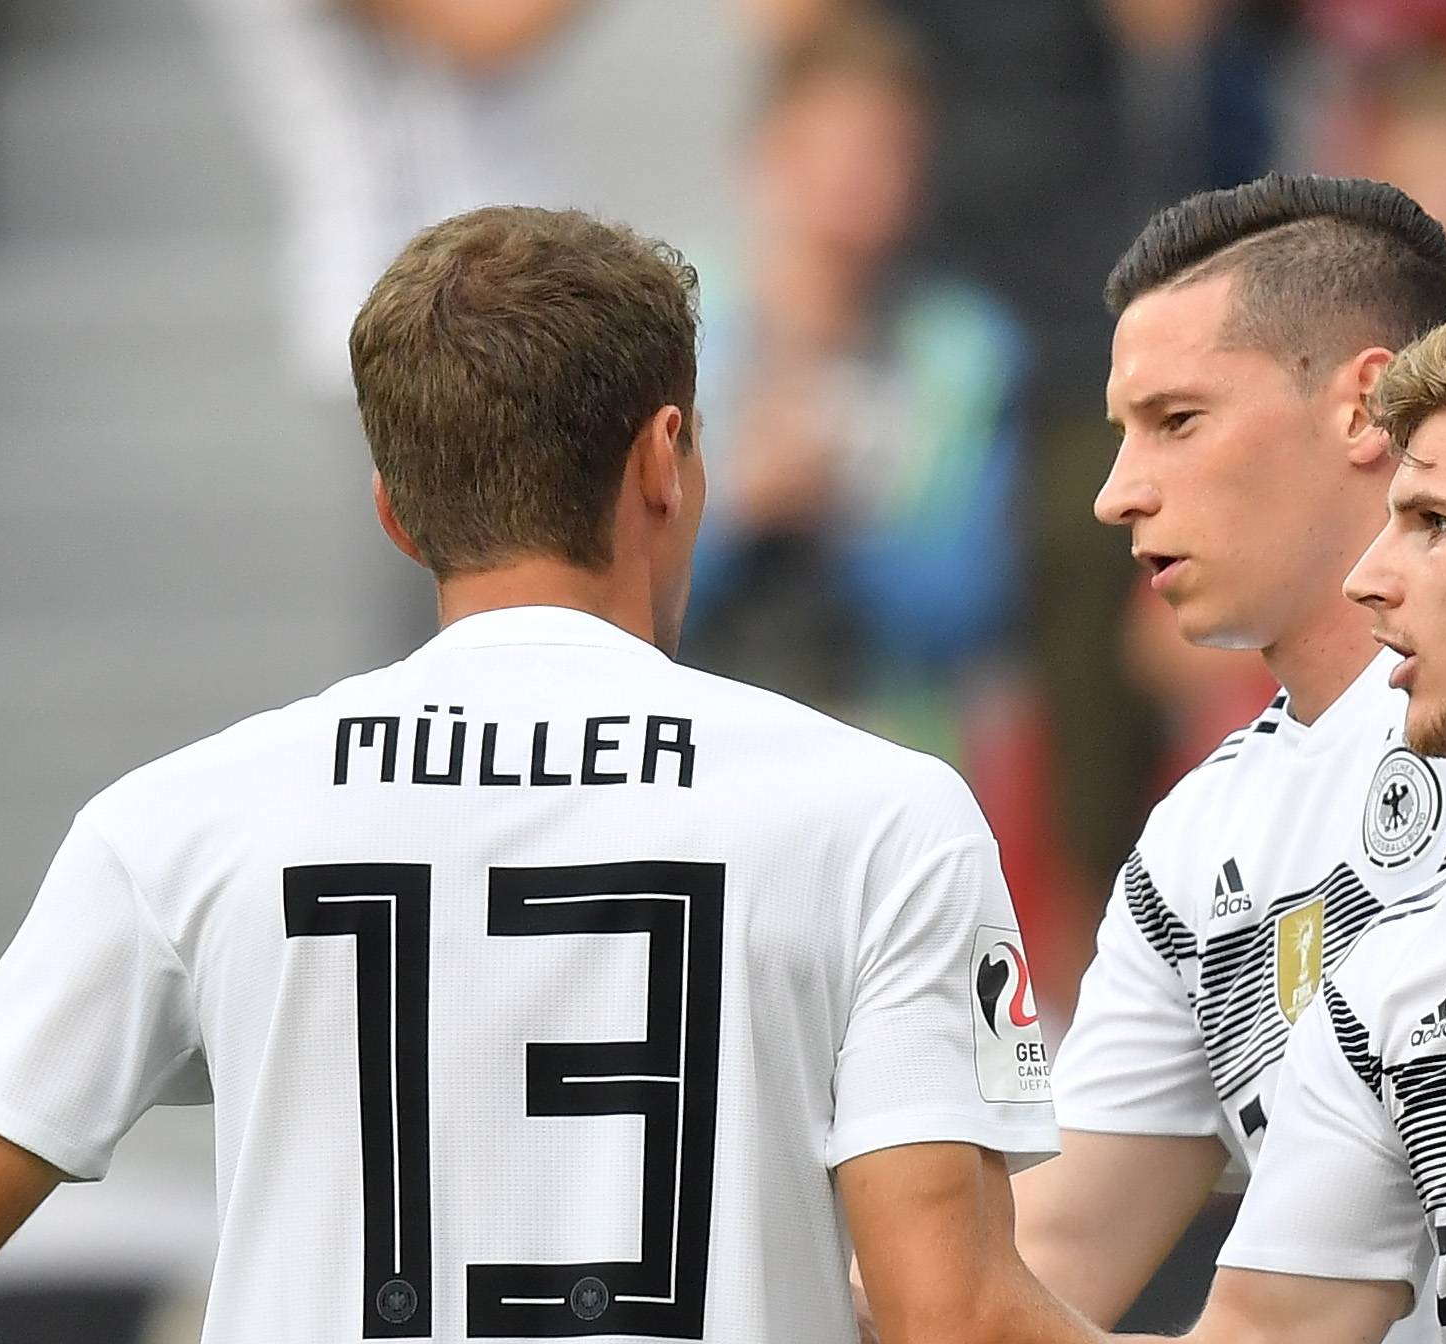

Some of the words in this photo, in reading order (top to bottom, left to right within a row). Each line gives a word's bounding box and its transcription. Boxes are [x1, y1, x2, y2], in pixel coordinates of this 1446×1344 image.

[334, 705, 696, 787] MÜLLER
[1209, 892, 1252, 920] idas
[282, 860, 726, 1339] 13
